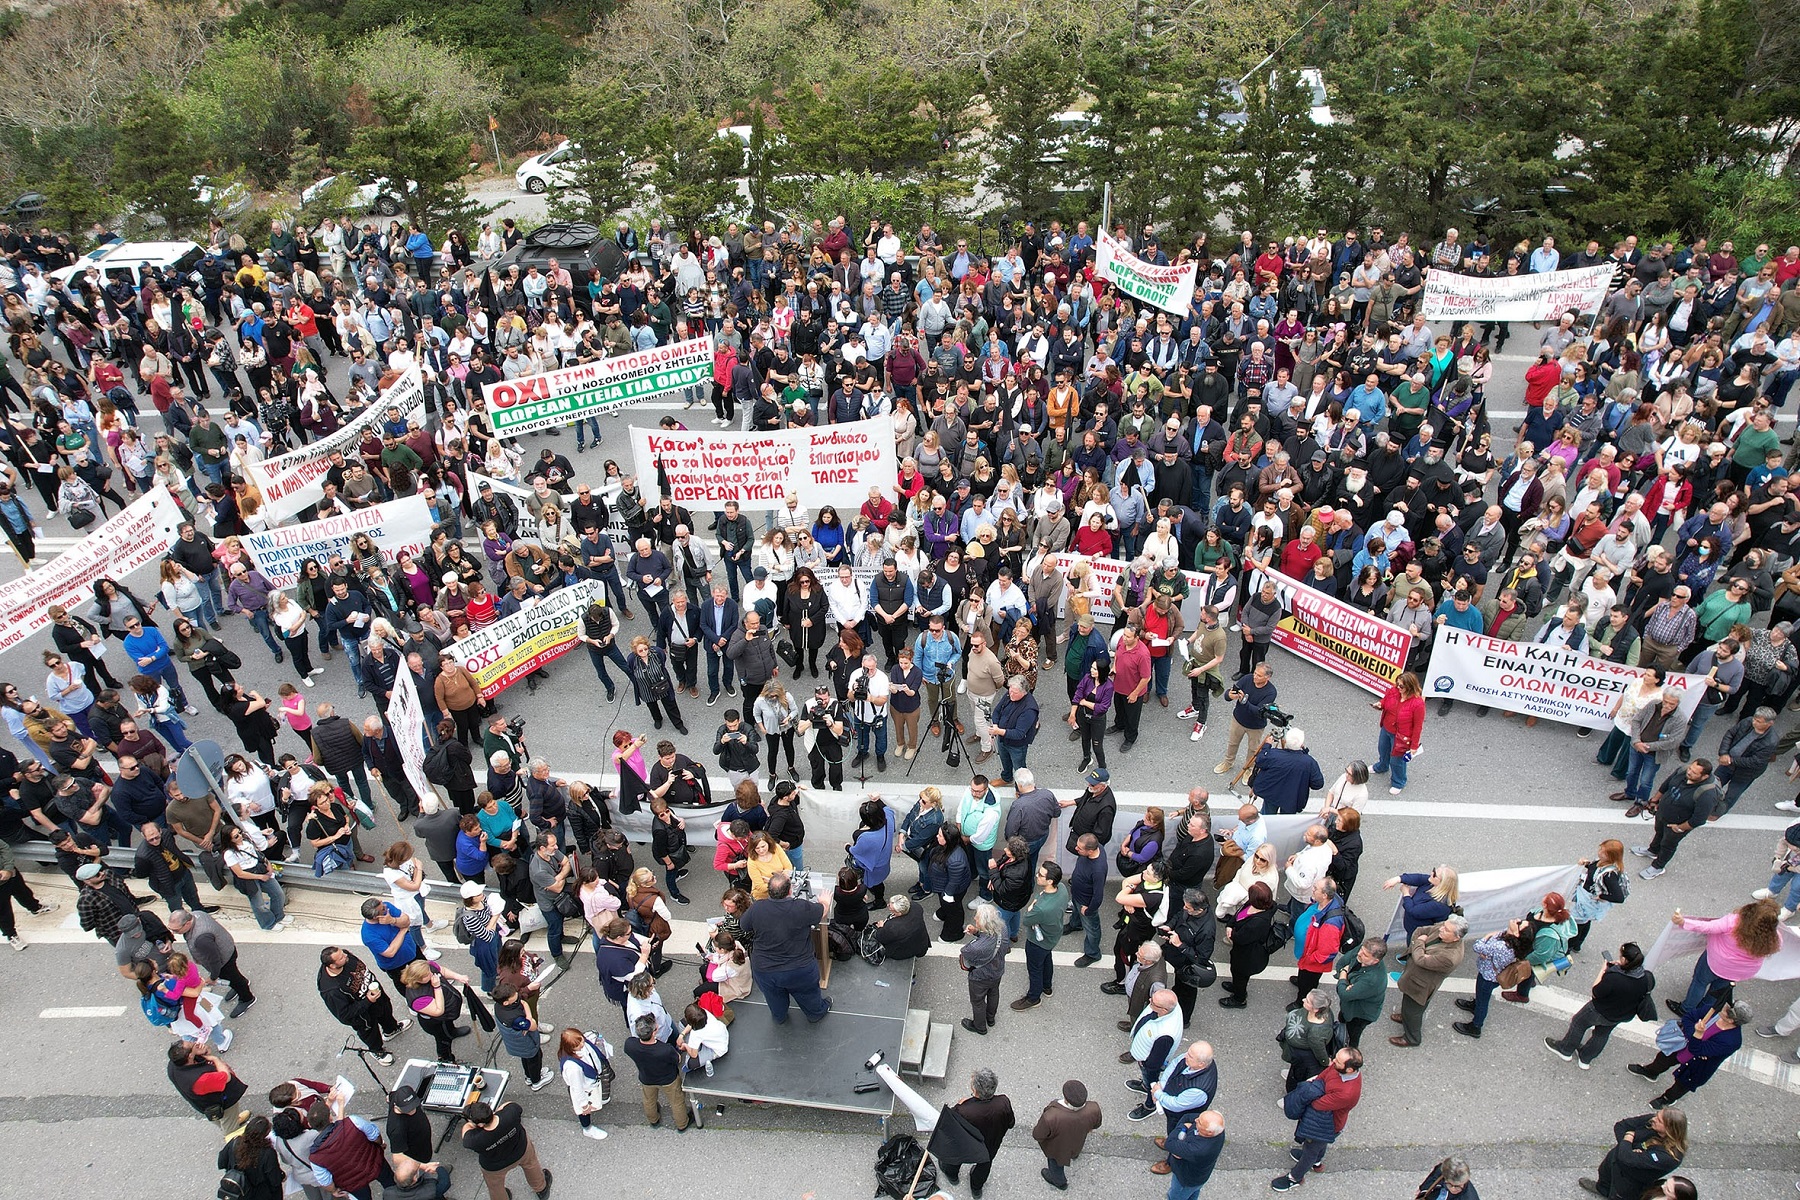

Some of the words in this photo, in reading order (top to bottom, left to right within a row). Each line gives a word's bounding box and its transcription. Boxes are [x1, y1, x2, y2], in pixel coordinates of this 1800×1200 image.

[1117, 276, 1134, 293] ΓΙΑ
[1136, 285, 1169, 307] ΟΛΟΥΣ
[1443, 295, 1477, 308] ΜΙΣΘΟΥΣ
[1547, 293, 1583, 304] ΔΡΟΜΟΙ
[553, 366, 595, 386] ΣΤΗΝ
[606, 340, 709, 374] ΥΠΟΒΑΘΜΙΣΗ
[556, 384, 578, 397] ΤΟΥ
[582, 363, 662, 391] ΝΟΣΟΚΟΜΕΙΟΥ
[665, 352, 711, 370] ΣΗΤΕΙΑΣ
[492, 377, 551, 408] ΟΧΙ
[499, 398, 572, 426] ΔΩΡΕΑΝ
[573, 386, 622, 408] ΥΓΕΙΑ
[625, 378, 655, 397] ΓΙΑ
[655, 364, 712, 388] ΟΛΟΥΣ
[502, 418, 552, 436] ΣΥΛΛΟΓΟΣ
[553, 404, 610, 428] ΣΥΝΕΡΓΕΙΩΝ
[612, 389, 676, 410] ΑΥΤΟΚΙΝΗΤΩΝ
[810, 428, 868, 446] Συνδικάτο
[266, 484, 283, 503] ΝΑ
[282, 472, 304, 495] ΜΗΝ
[297, 456, 332, 484] ΠΕΡΑΣΕΙ
[811, 468, 859, 484] ΤΑΛΩΣ
[674, 485, 740, 501] ΔΩΡΕΑΝ
[742, 484, 785, 500] ΥΓΕΙΑ
[249, 534, 274, 550] ΝΑΙ
[274, 529, 299, 547] ΣΤΗ
[302, 517, 353, 542] ΔΗΜΟΣΙΑ
[352, 508, 384, 529] ΥΓΕΙΑ
[0, 576, 35, 598] ΔΩΡΕΑΝ
[46, 555, 73, 573] ΥΓΕΙΑ
[78, 540, 95, 553] ΓΙΑ
[105, 510, 136, 533] ΟΛΟΥΣ
[0, 598, 18, 613] ΙΚΗ
[93, 544, 109, 559] ΑΠΟ
[109, 535, 123, 546] ΤΟ
[125, 511, 153, 536] ΚΡΑΤΟΣ
[114, 540, 132, 556] ΣΤΗΝ
[258, 541, 331, 564] ΠΟΛΙΤΙΣΤΙΚΟΣ
[8, 604, 36, 626] ΜΟΝΙΜΟΥ
[113, 533, 155, 564] ΠΡΟΣΩΠΙΚΟΥ
[264, 561, 294, 577] ΝΕΑΣ
[271, 575, 293, 588] ΟΧΙ
[0, 630, 25, 651] ΛΟΓΟΣ
[129, 539, 169, 569] ΛΑΣΙΘΙΟΥ
[458, 632, 493, 658] ΥΓΕΙΑ
[494, 616, 522, 641] ΕΙΝΑΙ
[524, 592, 570, 624] ΚΟΙΝΩΝΙΚΟ
[466, 644, 503, 673] ΟΧΙ
[511, 596, 596, 650] ΕΜΠΟΡΕΥΜΑ
[1292, 618, 1311, 637] ΤΟΥ
[1297, 592, 1321, 610] ΣΤΟ
[1320, 603, 1379, 639] ΚΛΕΙΣΙΜΟ
[1381, 629, 1404, 648] ΚΑΙ
[1297, 608, 1319, 629] ΤΗΝ
[1322, 620, 1400, 664] ΥΠΟΒΑΘΜΙΣΗ
[1445, 632, 1459, 645] Η
[1465, 634, 1518, 656] ΥΓΕΙΑ
[1525, 646, 1559, 662] ΚΑΙ
[1563, 654, 1578, 667] Η
[1483, 655, 1534, 675] ΕΙΝΑΙ
[481, 683, 501, 697] ΤΕΙΑ
[501, 678, 507, 686] &
[1465, 683, 1498, 695] ΕΝΩΣΗ
[1500, 690, 1572, 709] ΑΣΤΥΝΟΜΙΚΩΝ
[1500, 674, 1556, 695] ΟΛΩΝ
[1561, 685, 1610, 707] ΜΑΣ!
[1523, 703, 1570, 718] ΛΑΣΙΘΙΟΥ
